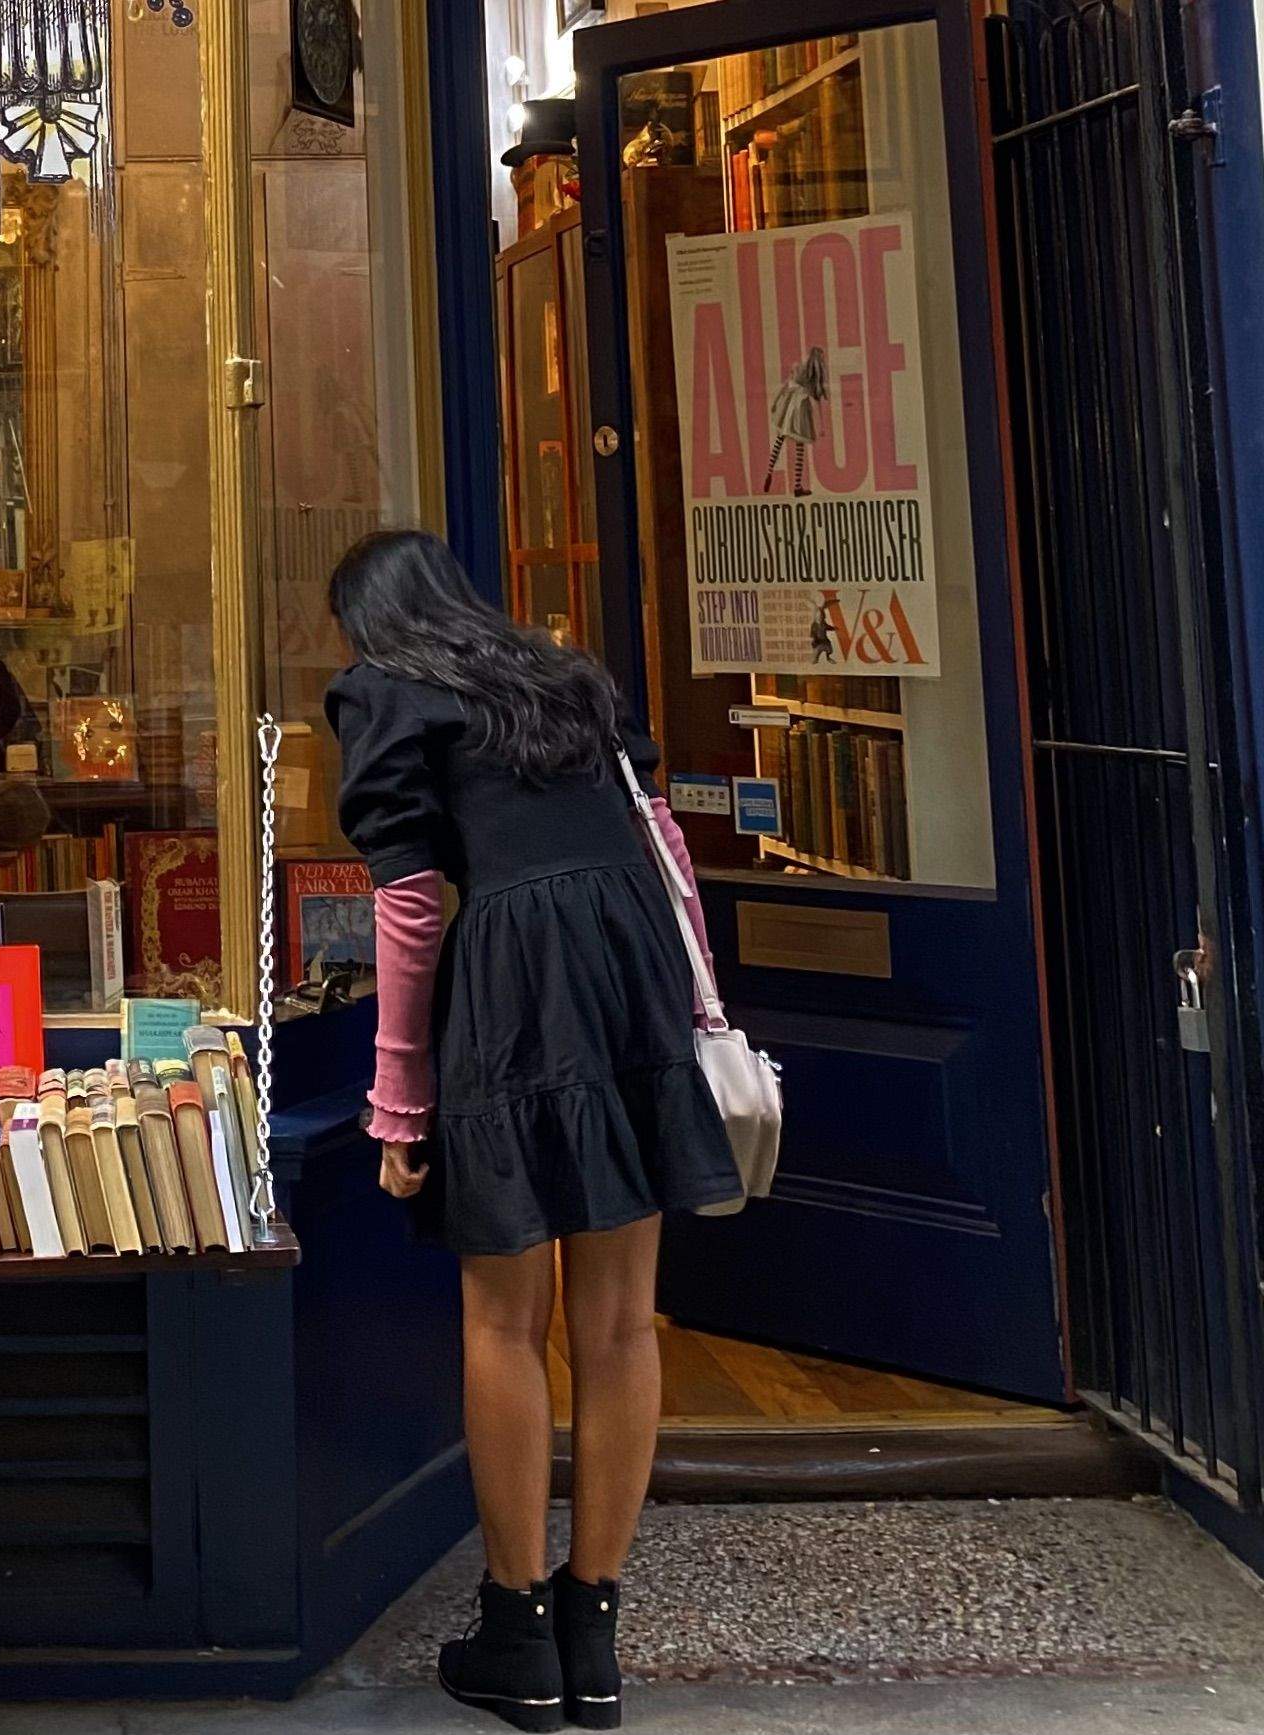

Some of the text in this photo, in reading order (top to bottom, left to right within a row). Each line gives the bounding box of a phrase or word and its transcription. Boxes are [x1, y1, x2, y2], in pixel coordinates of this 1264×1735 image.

[691, 225, 918, 497] ALICE
[697, 589, 759, 624] STEP INTO
[816, 588, 930, 665] V&A
[699, 627, 763, 663] WONDERLAND
[294, 863, 372, 879] OLD FREN
[295, 879, 374, 893] FAIRY TAL
